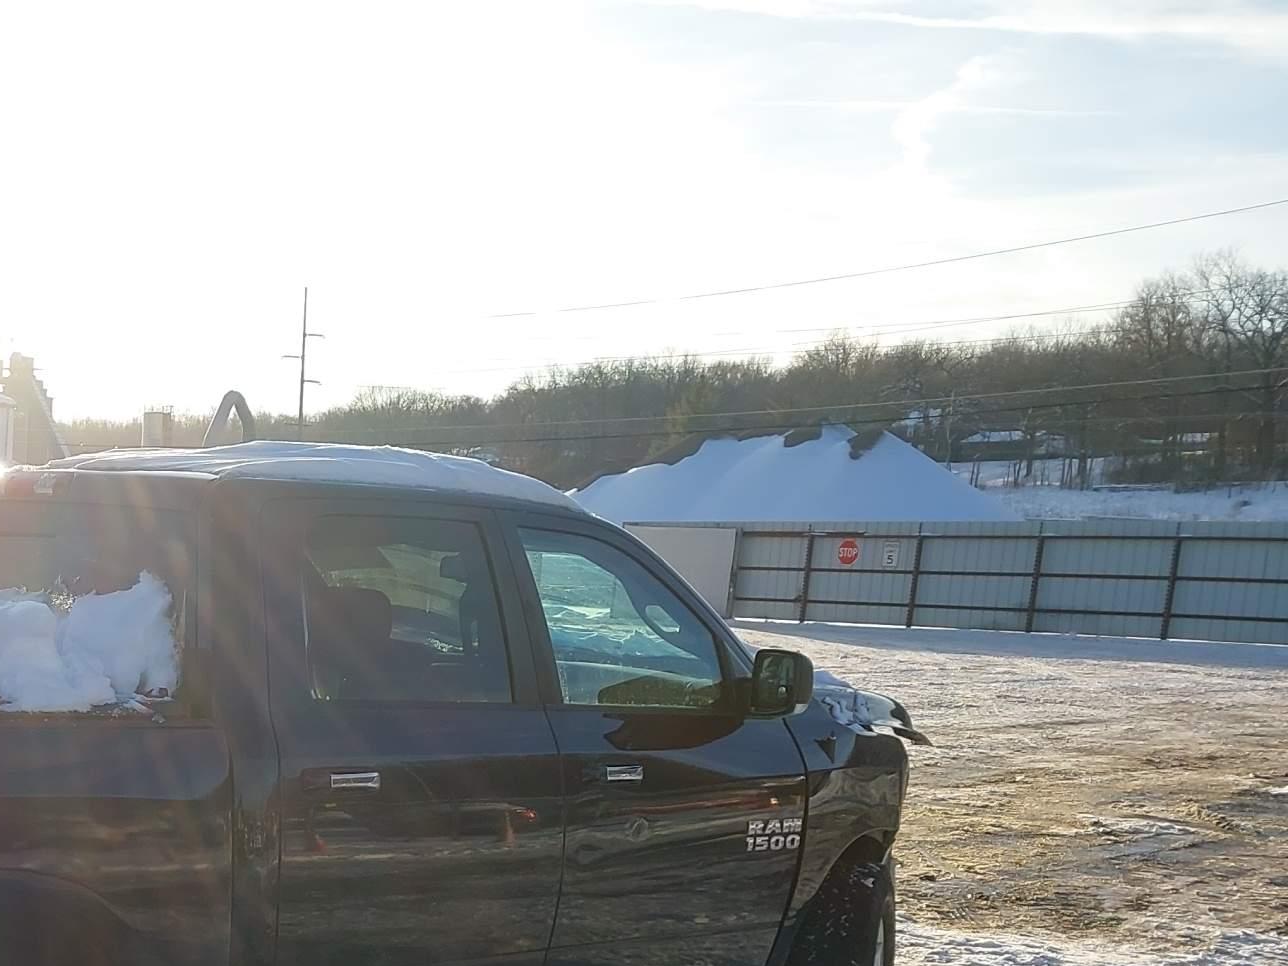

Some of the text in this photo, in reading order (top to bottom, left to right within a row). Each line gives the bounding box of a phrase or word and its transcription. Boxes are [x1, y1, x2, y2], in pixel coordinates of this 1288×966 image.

[839, 547, 858, 558] STOP
[886, 554, 894, 565] 5
[748, 818, 803, 835] RAM
[746, 834, 801, 852] 1500
